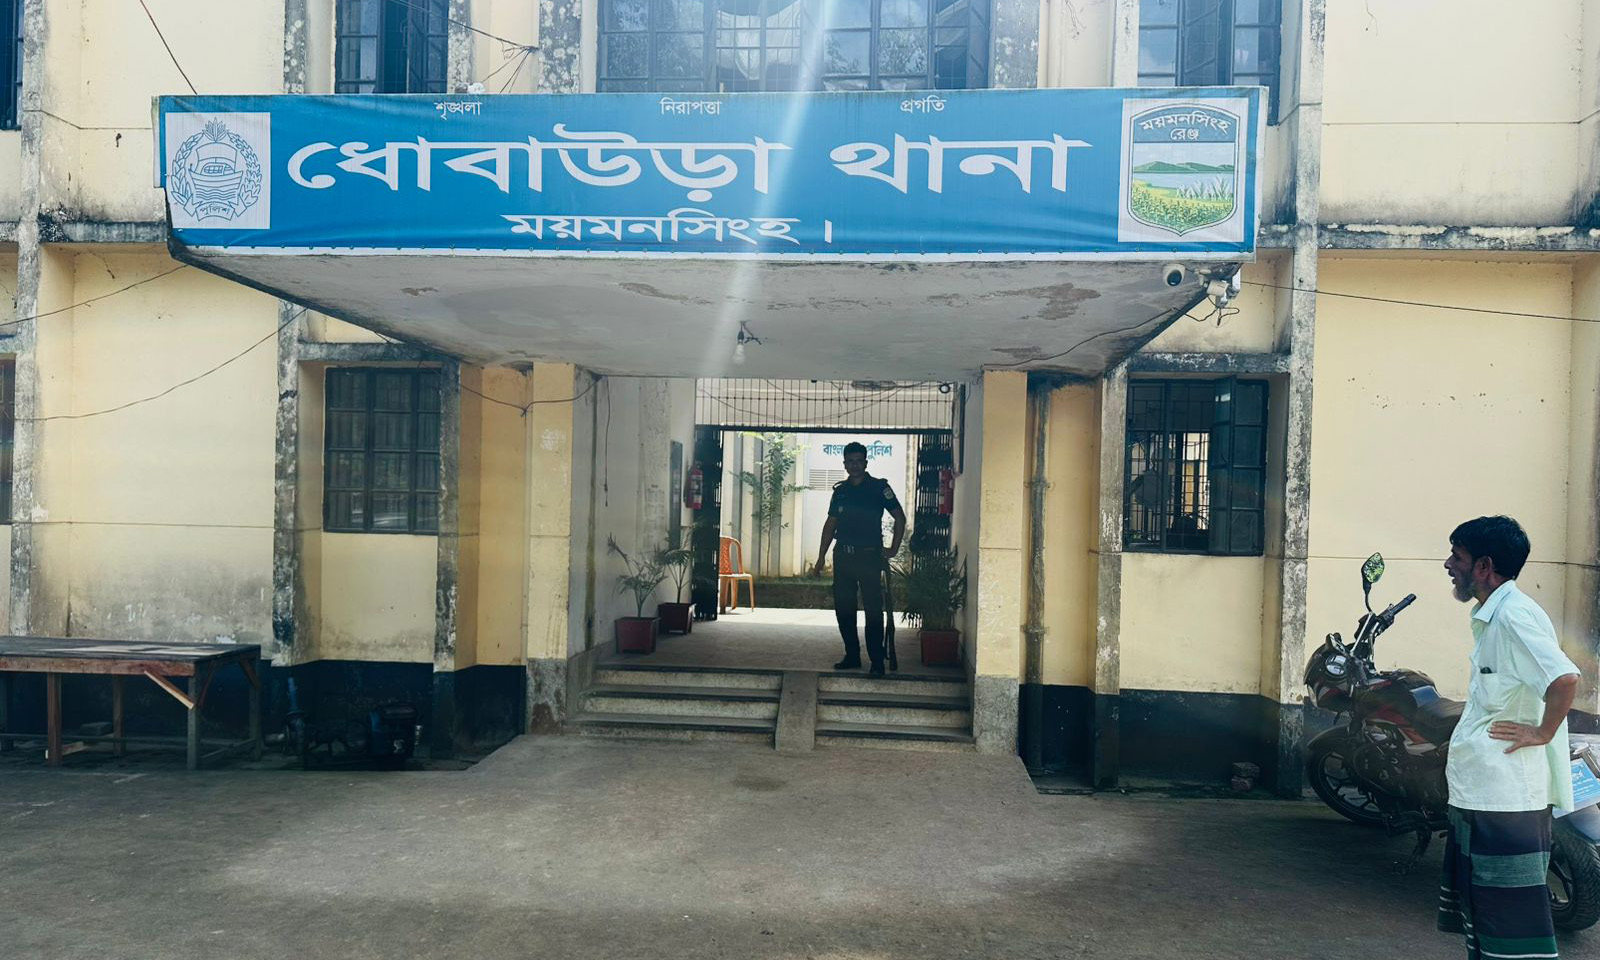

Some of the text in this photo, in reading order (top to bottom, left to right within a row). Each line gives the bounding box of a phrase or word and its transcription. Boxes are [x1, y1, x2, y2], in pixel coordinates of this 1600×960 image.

[433, 100, 482, 120] শৃঙ্খলা
[659, 97, 723, 115] নিরাপত্তা
[900, 94, 947, 113] প্রগতি
[1138, 110, 1231, 134] ময়মনসিংহ
[1170, 128, 1200, 140] রেঞ্জ
[287, 123, 1094, 202] ধোবাউড়া থানা
[500, 207, 801, 246] ময়মনসিংহ
